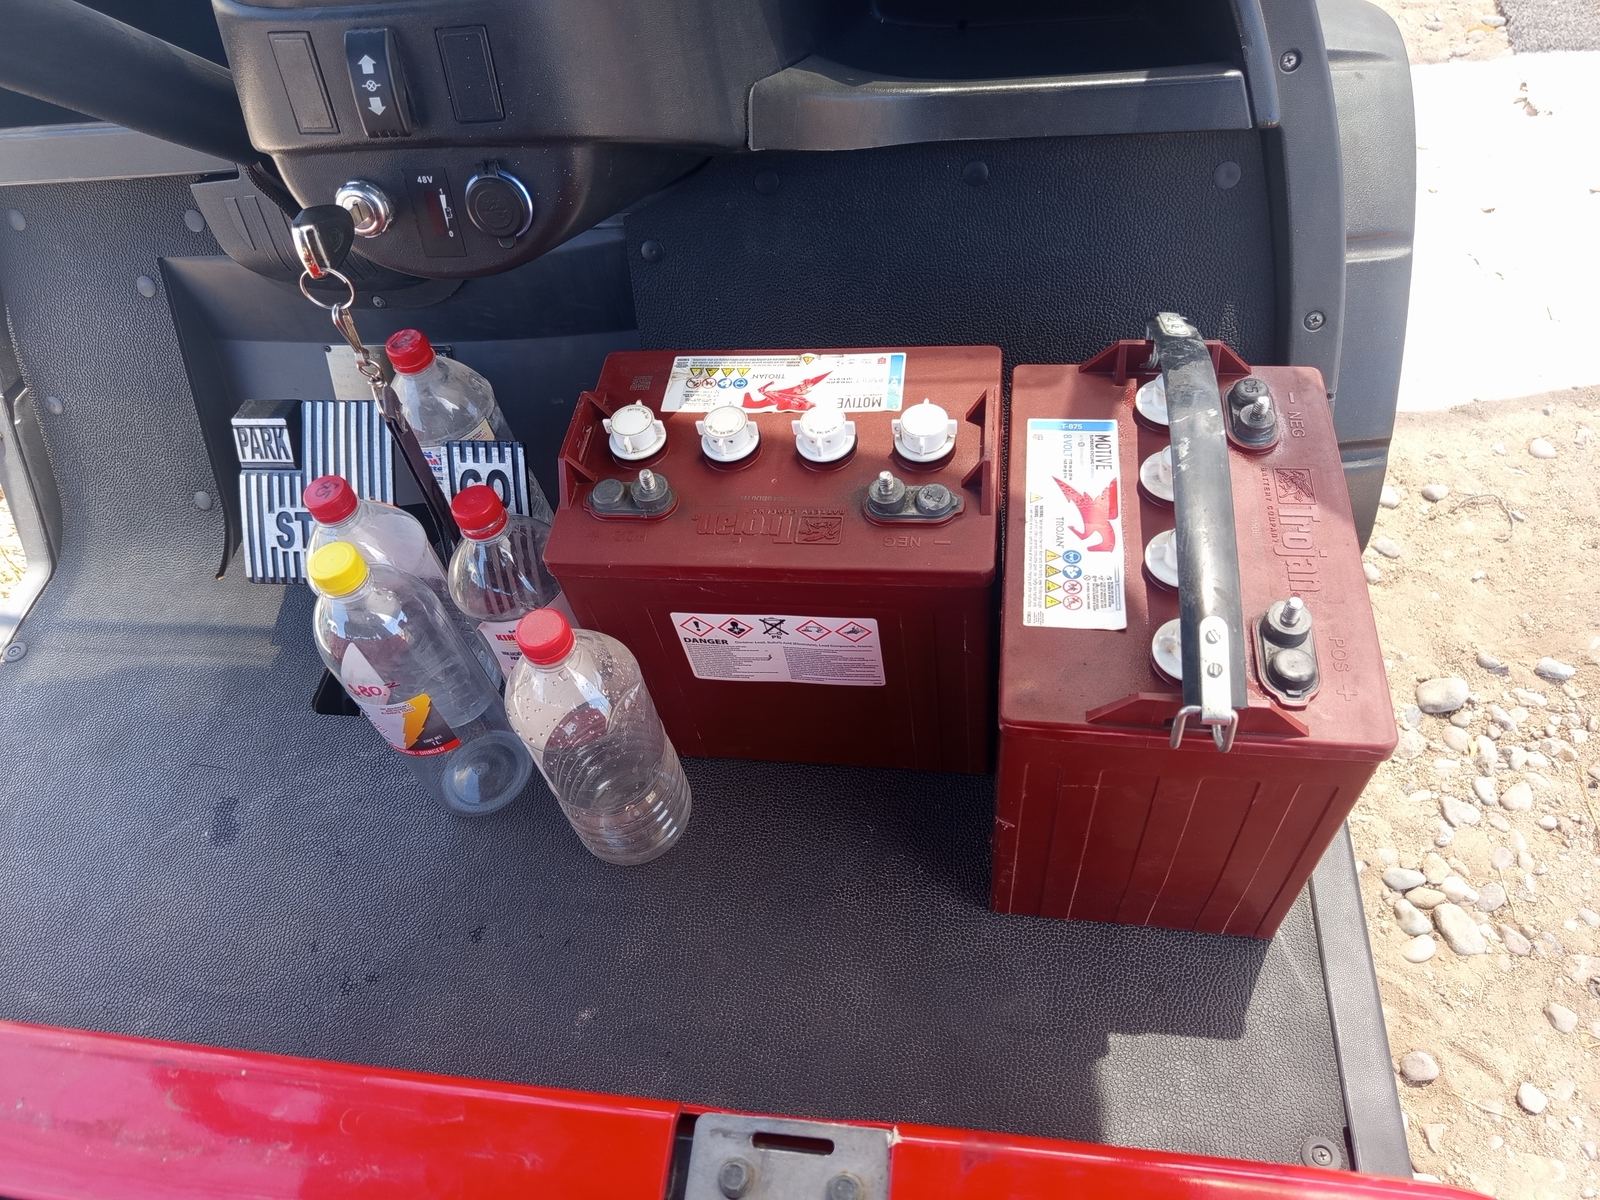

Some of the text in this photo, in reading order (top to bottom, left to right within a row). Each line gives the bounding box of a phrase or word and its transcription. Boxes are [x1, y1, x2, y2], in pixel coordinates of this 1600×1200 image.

[417, 175, 433, 184] 48V
[837, 396, 882, 409] MOTIVE
[1288, 411, 1305, 439] NEG
[238, 428, 292, 461] PARK
[1063, 439, 1073, 457] VOLT
[1095, 434, 1112, 470] MOTIVE
[696, 513, 794, 544] Trojan
[1055, 517, 1064, 546] TROJAN
[1266, 505, 1279, 543] COMPANY
[882, 536, 921, 548] NEG
[1273, 506, 1329, 593] Trojan
[683, 637, 729, 646] DANGER
[1329, 638, 1351, 673] POS
